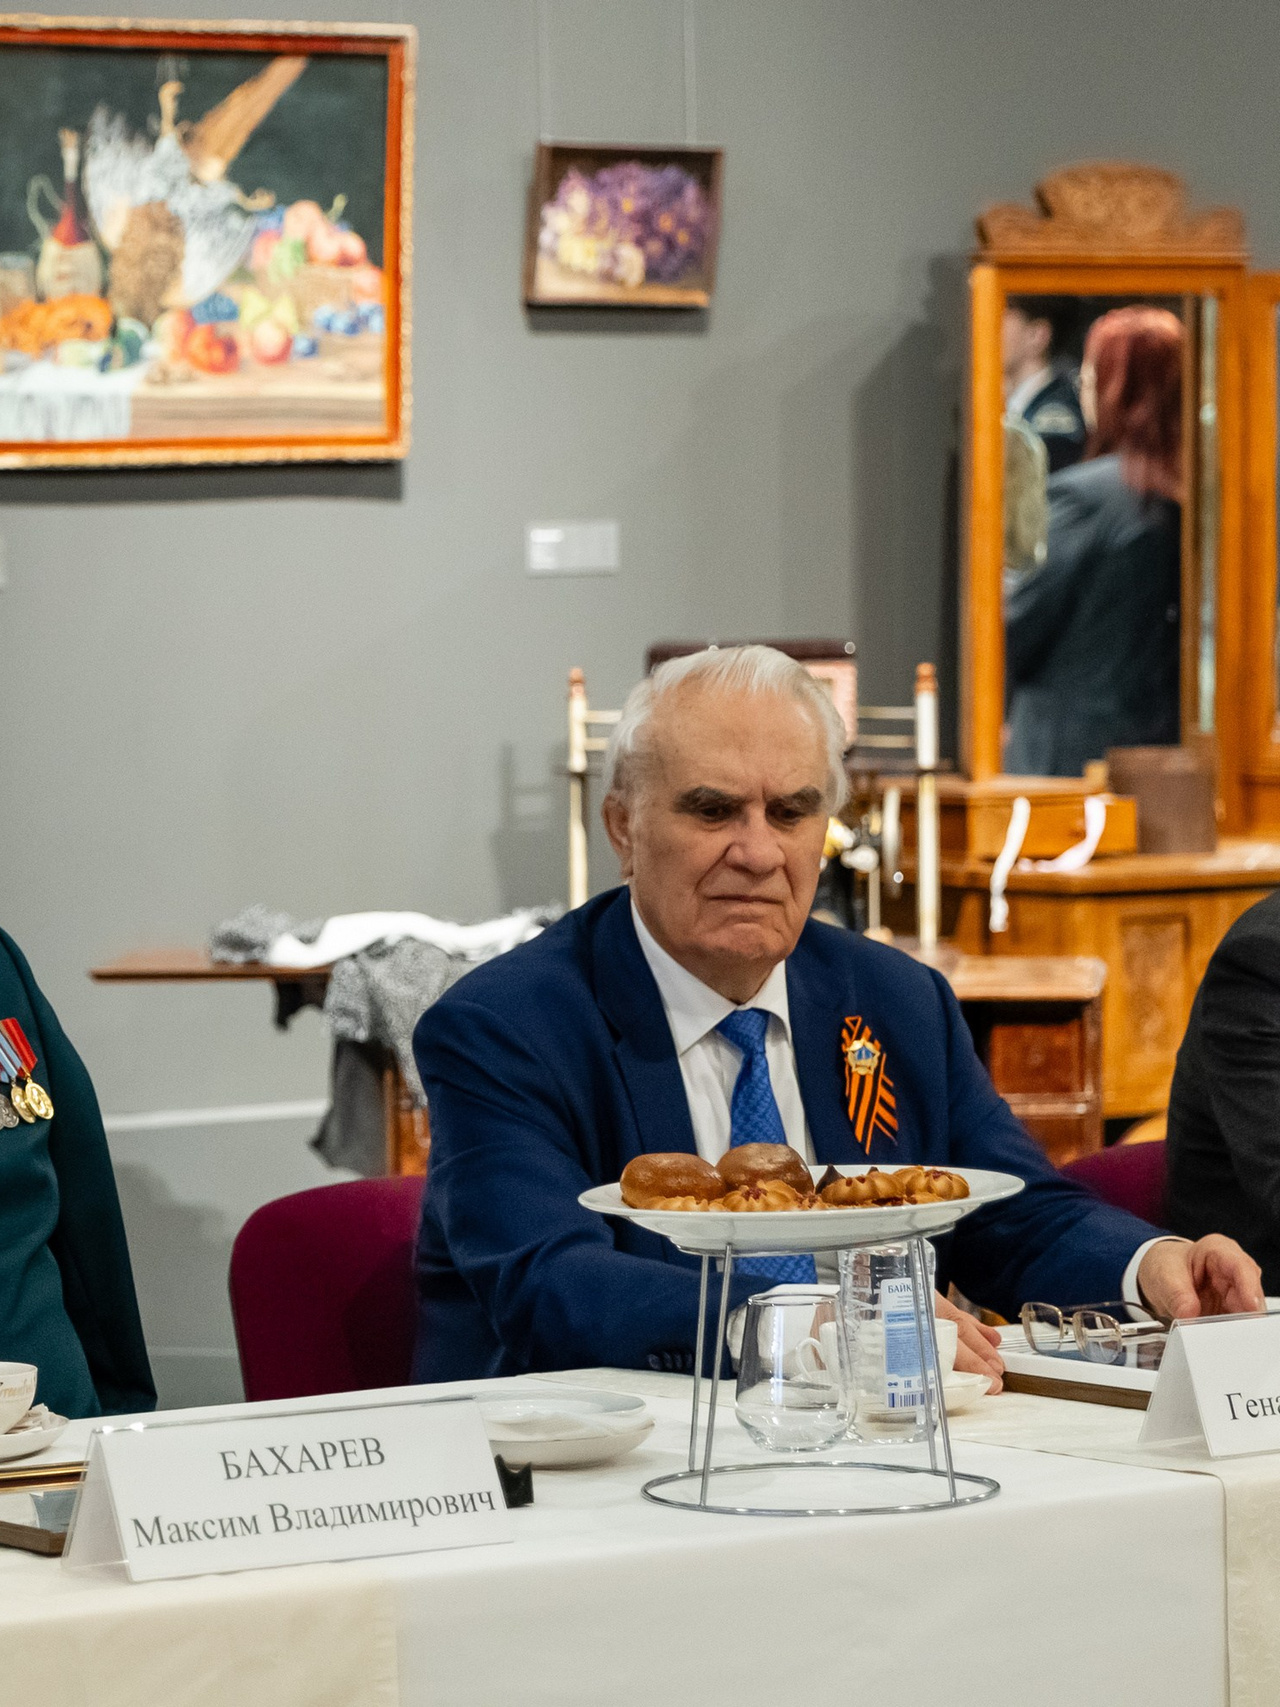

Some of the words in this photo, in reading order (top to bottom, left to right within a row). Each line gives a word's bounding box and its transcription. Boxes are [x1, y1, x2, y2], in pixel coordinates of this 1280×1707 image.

[218, 1436, 387, 1481] БАХАРЕВ
[130, 1513, 262, 1549] Максим
[266, 1490, 497, 1534] Владимирович
